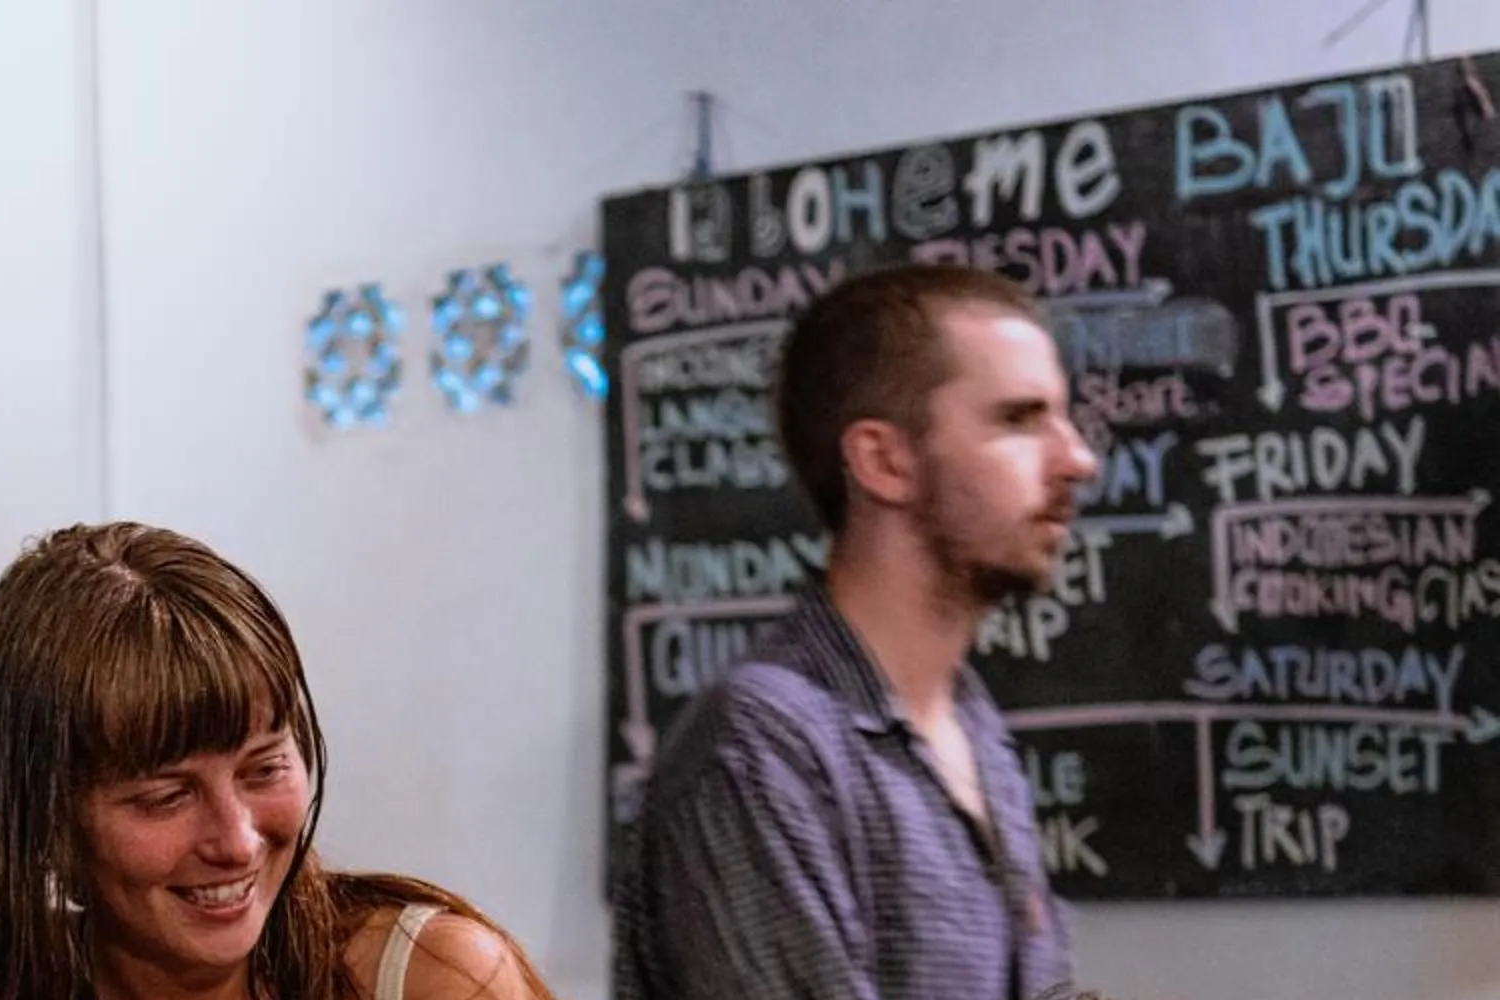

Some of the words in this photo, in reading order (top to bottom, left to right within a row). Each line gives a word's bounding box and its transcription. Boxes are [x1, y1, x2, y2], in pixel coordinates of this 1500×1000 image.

[1195, 414, 1426, 504] FRIDAY
[1183, 642, 1465, 720] SATURDAY
[1222, 719, 1453, 793] SUNSET
[1233, 793, 1351, 872] TRIP
